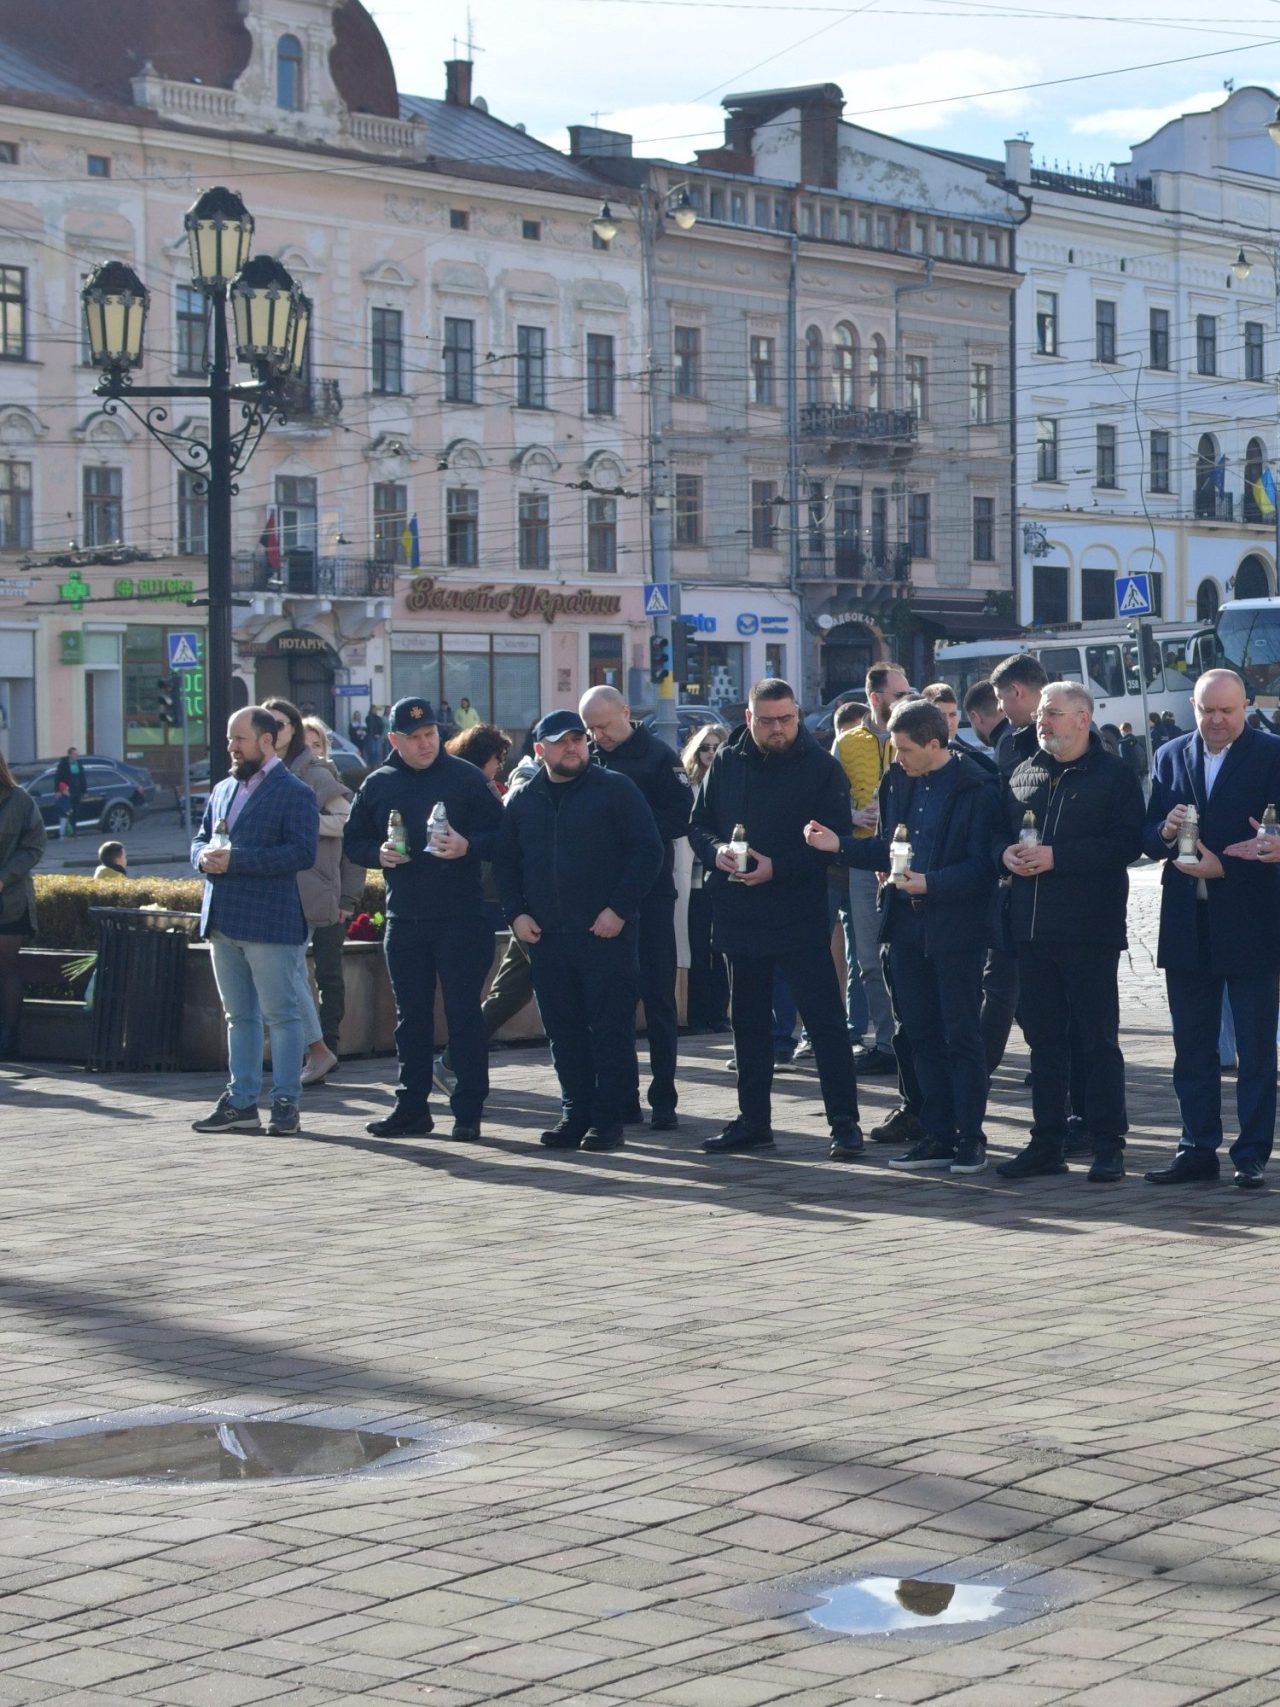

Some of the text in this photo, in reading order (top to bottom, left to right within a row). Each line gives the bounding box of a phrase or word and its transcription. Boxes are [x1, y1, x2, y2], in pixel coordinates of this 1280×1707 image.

[406, 575, 622, 625] Золото України
[278, 638, 328, 650] НОТАРІУС
